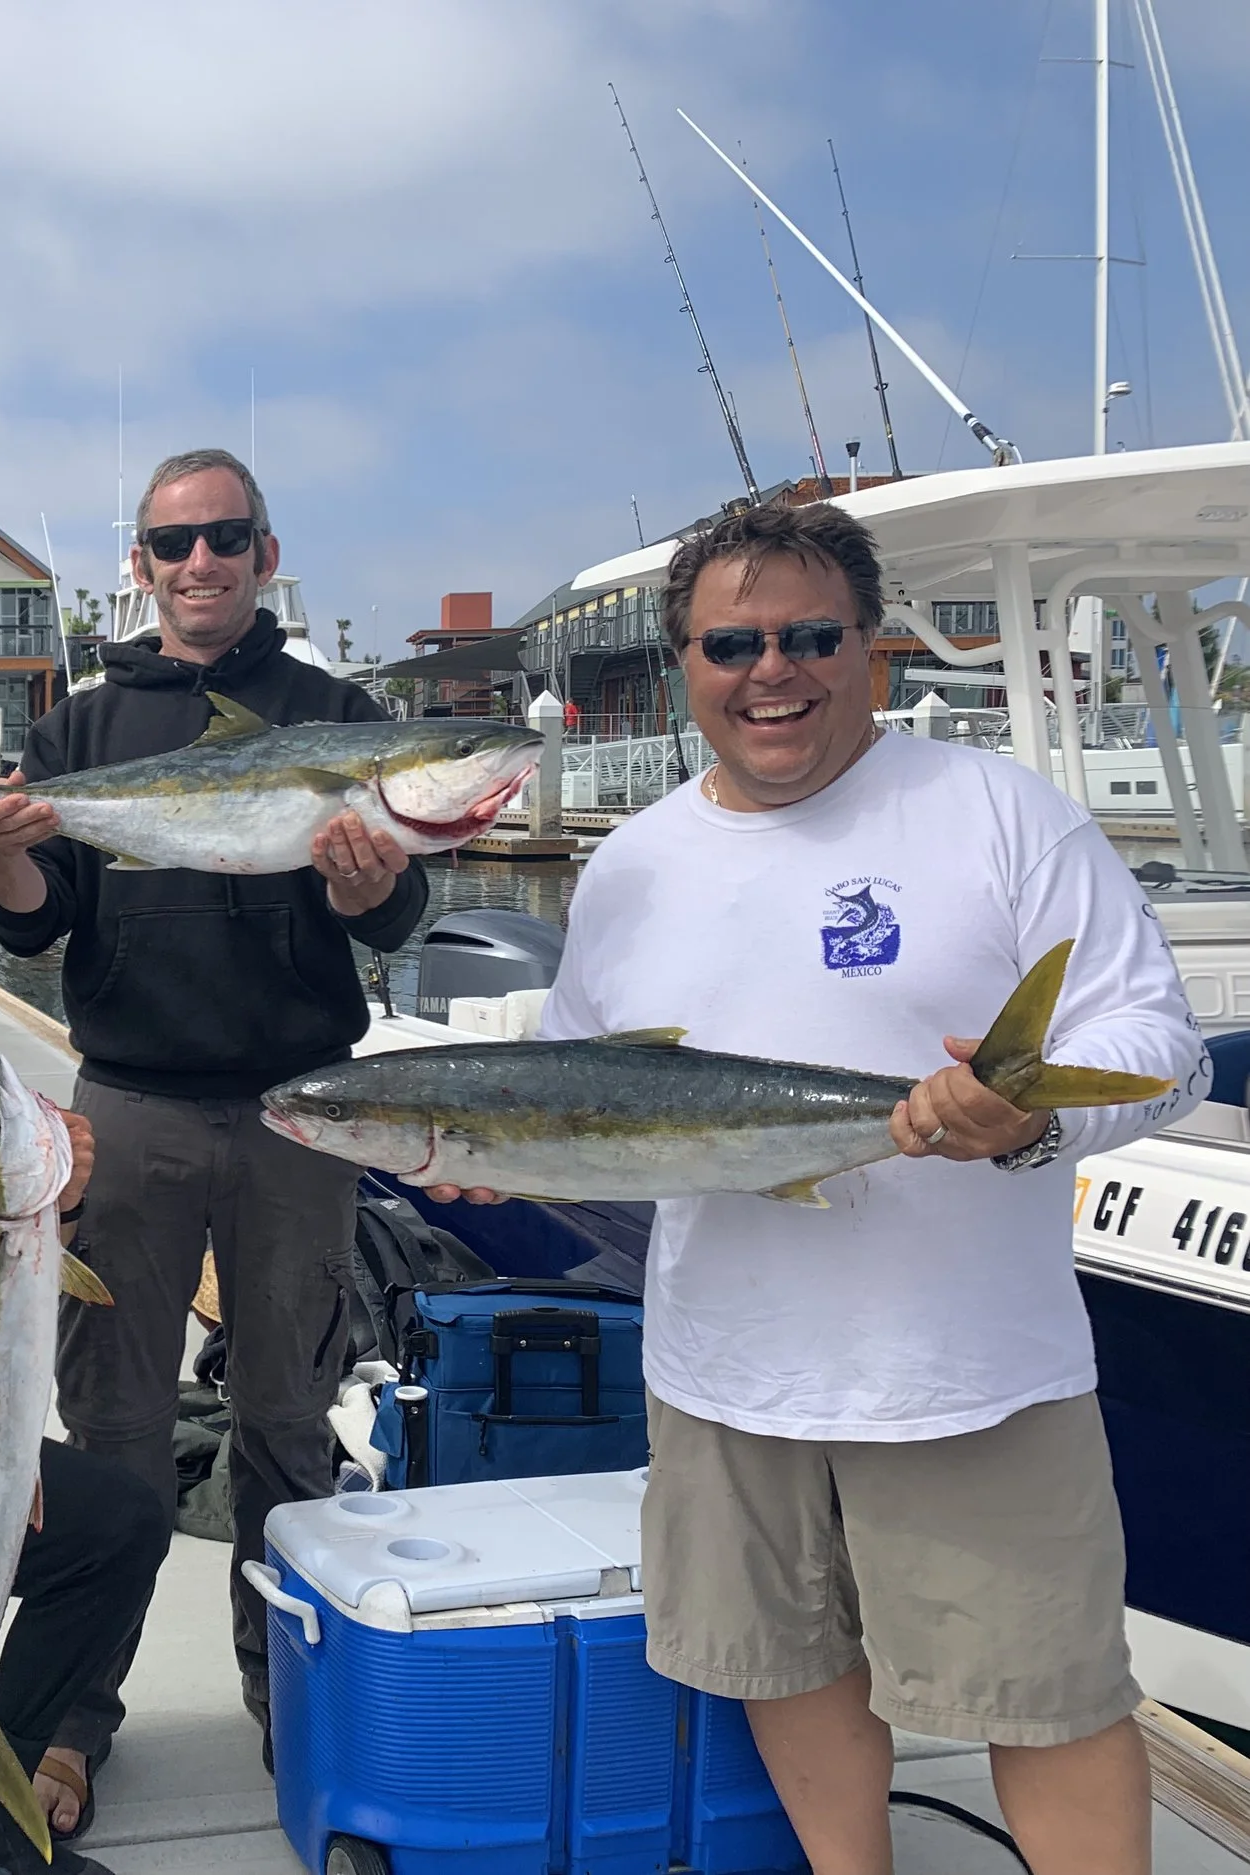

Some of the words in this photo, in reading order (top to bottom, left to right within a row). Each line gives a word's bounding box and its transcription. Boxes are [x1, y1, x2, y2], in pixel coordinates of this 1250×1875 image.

[825, 880, 850, 897] CABO
[851, 876, 871, 886] SAN
[873, 877, 902, 893] LUCAS
[841, 967, 882, 979] MEXICO
[1093, 1180, 1145, 1237] CF
